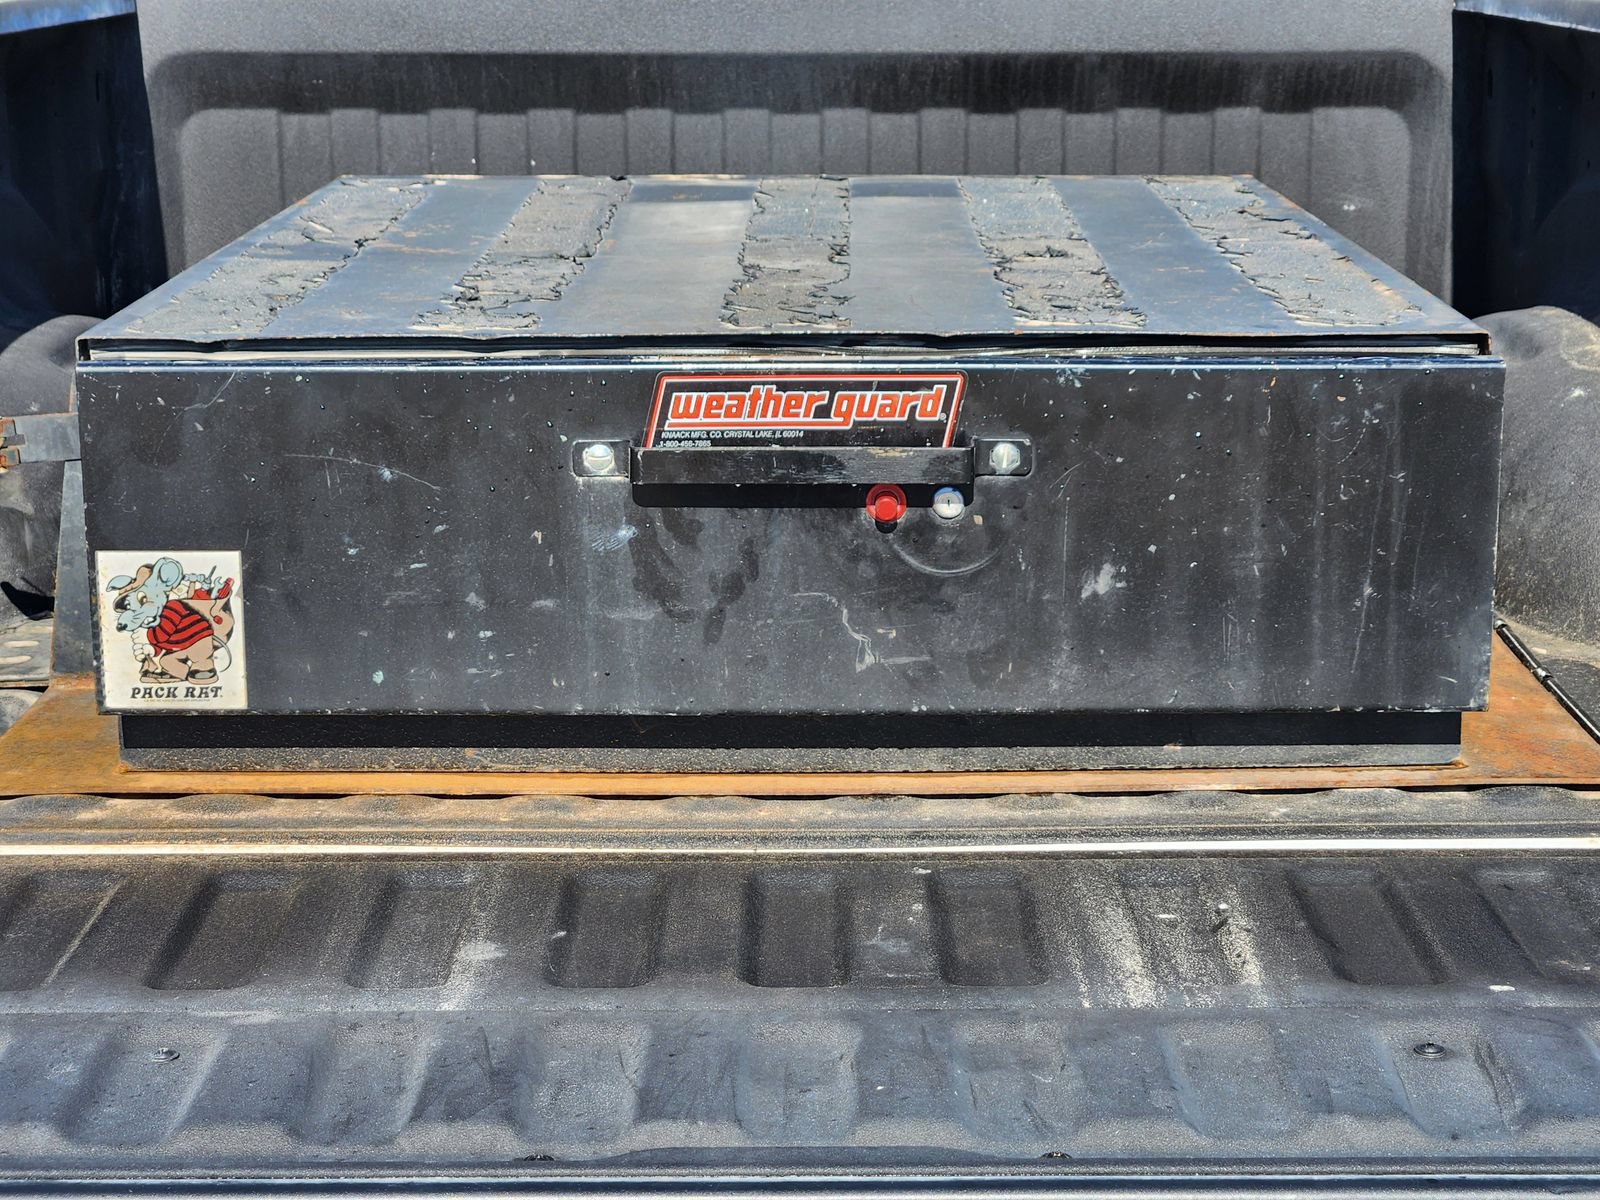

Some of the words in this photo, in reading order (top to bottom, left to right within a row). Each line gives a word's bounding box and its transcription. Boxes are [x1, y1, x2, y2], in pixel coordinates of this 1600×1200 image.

[669, 384, 830, 421] weather
[831, 384, 946, 428] guard
[661, 431, 690, 439] KNAACK
[691, 431, 707, 439] MFG.
[723, 430, 754, 439] CRYSTAL
[755, 430, 774, 439] LAKE,
[783, 430, 804, 438] 60014
[130, 686, 178, 699] PACK
[184, 686, 223, 699] RAT
